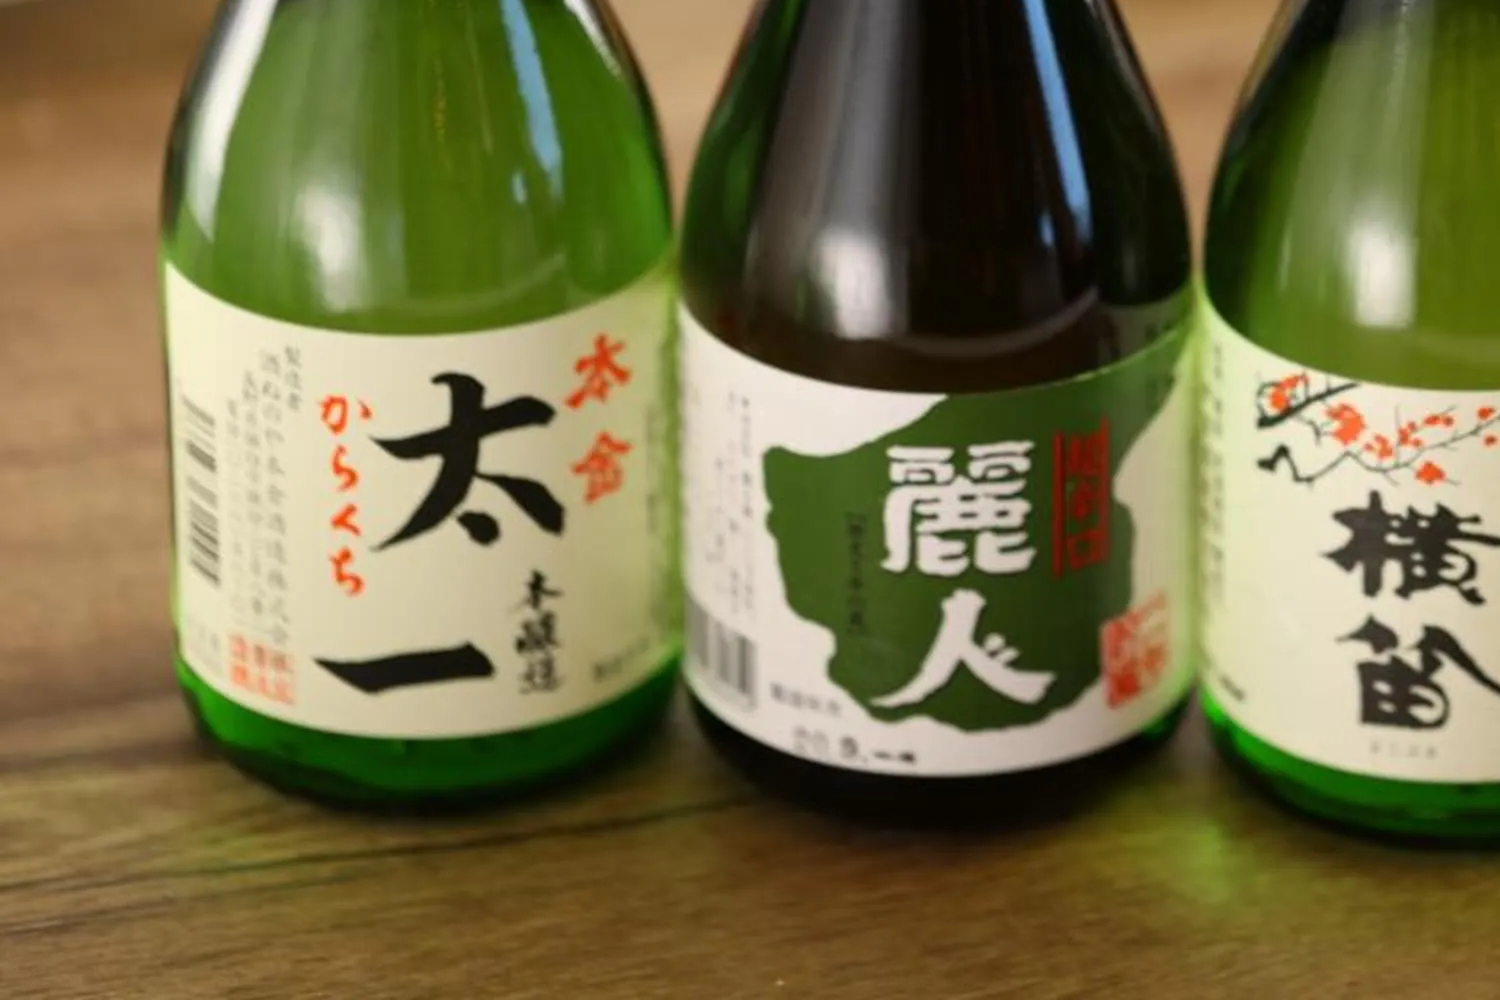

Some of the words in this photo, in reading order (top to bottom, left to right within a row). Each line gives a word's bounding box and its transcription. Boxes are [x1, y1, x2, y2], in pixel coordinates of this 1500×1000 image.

[315, 372, 567, 695] 太一
[319, 394, 372, 597] からくち
[880, 440, 1056, 708] 麗人
